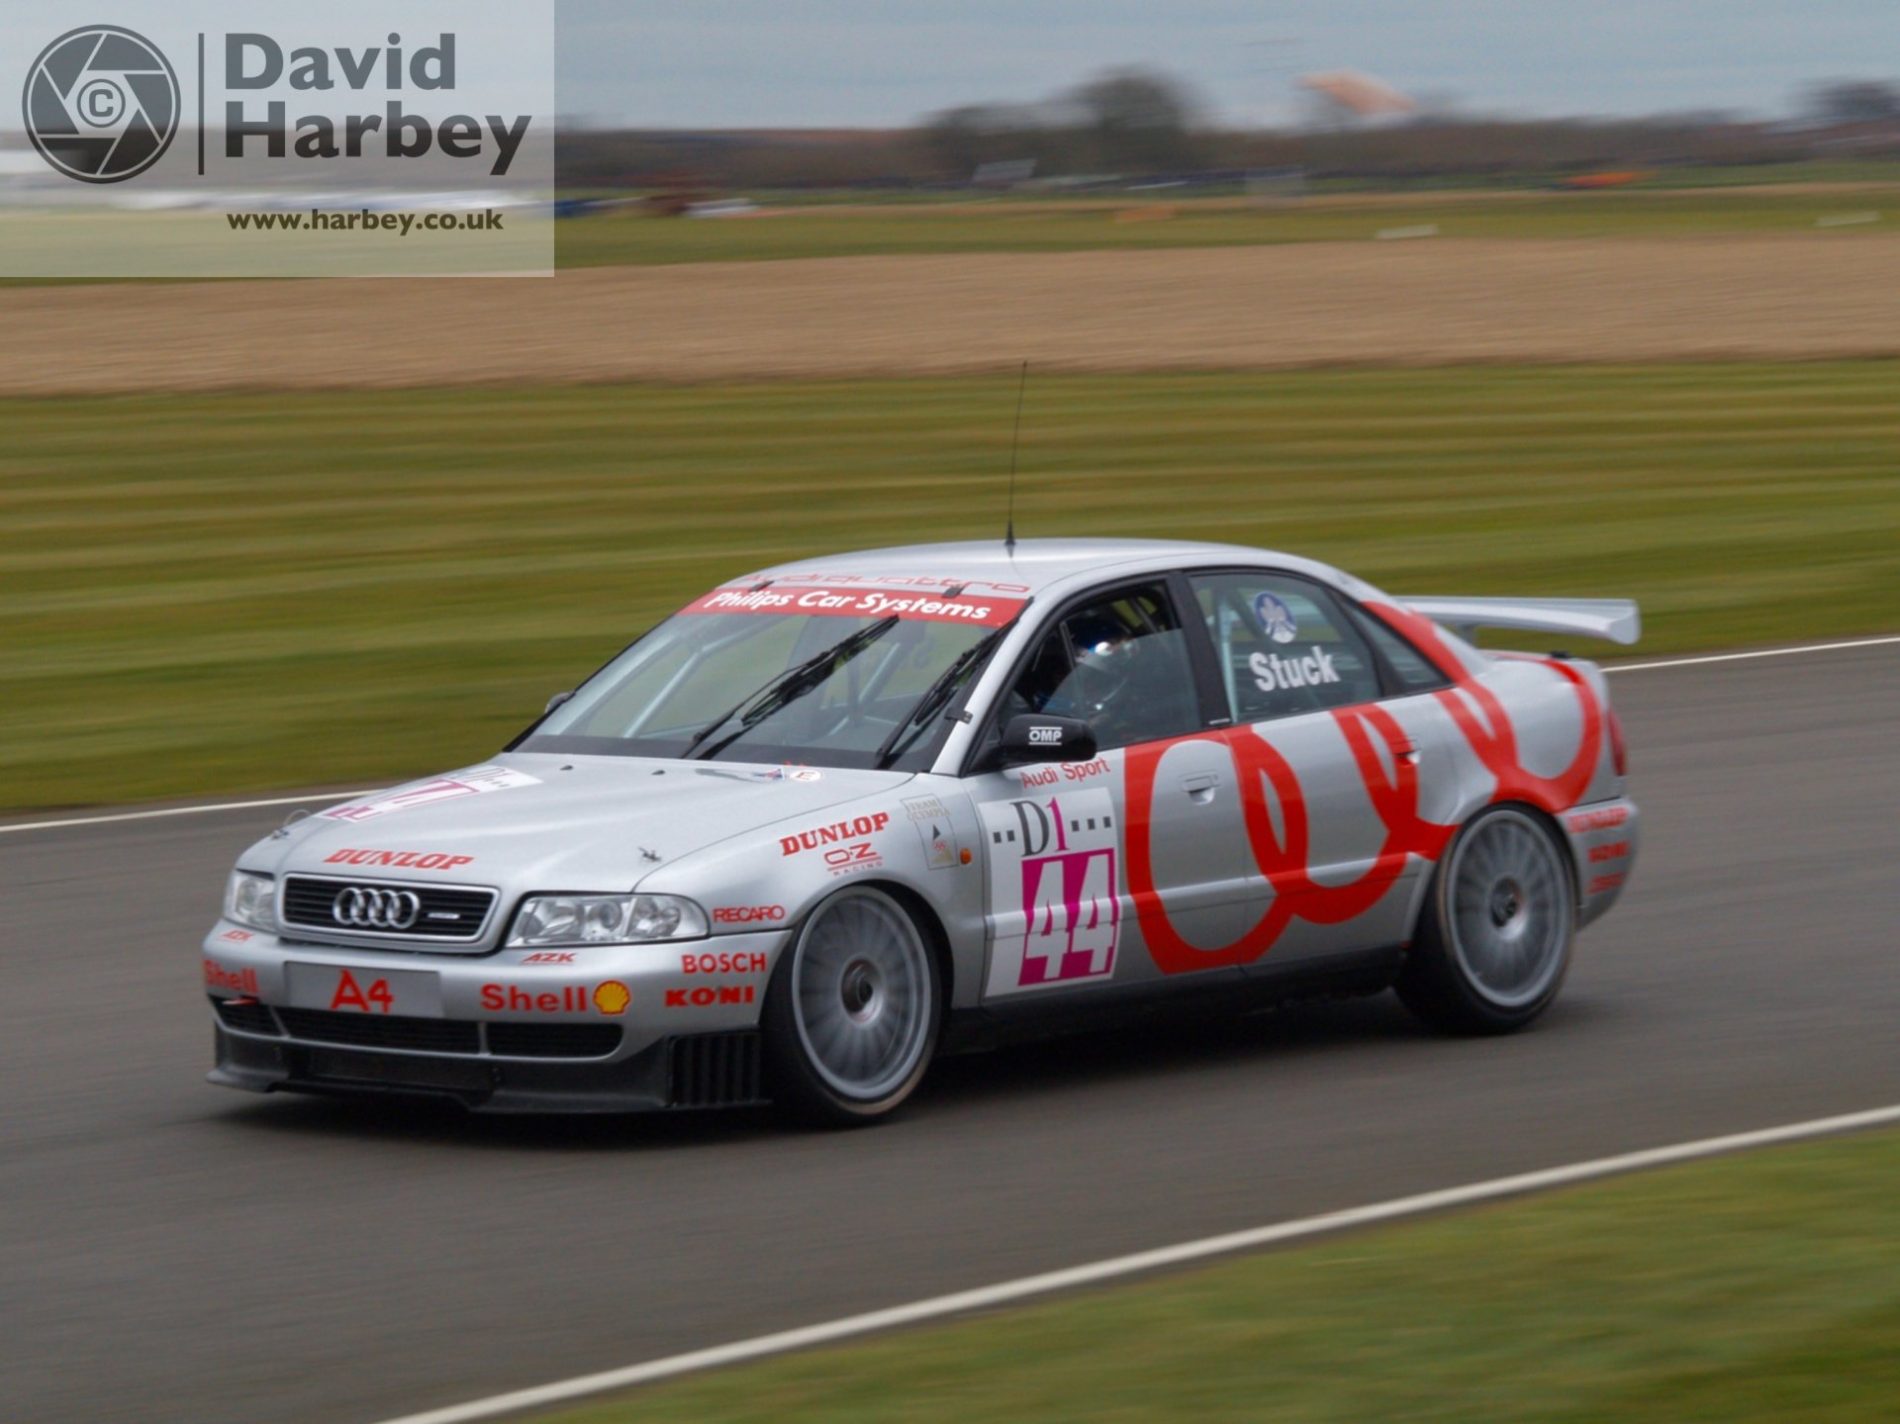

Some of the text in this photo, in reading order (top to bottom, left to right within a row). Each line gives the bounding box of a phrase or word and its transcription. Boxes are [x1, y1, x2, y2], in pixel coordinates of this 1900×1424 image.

[703, 588, 991, 619] Philips Car Systems
[1249, 645, 1341, 691] Stuck
[1028, 730, 1063, 742] OMP
[1020, 757, 1111, 789] Audi Sport
[779, 812, 889, 856] DUNLOP
[323, 848, 475, 870] DUNLOP
[824, 842, 878, 865] OZ
[833, 861, 883, 876] RACING
[712, 905, 785, 922] RECARO
[1024, 852, 1116, 982] 44
[521, 952, 577, 964] AZK
[681, 952, 768, 974] BOSCH
[203, 958, 260, 993] Shell
[329, 968, 394, 1014] A4
[480, 983, 588, 1013] Shell
[664, 985, 755, 1008] KONI
